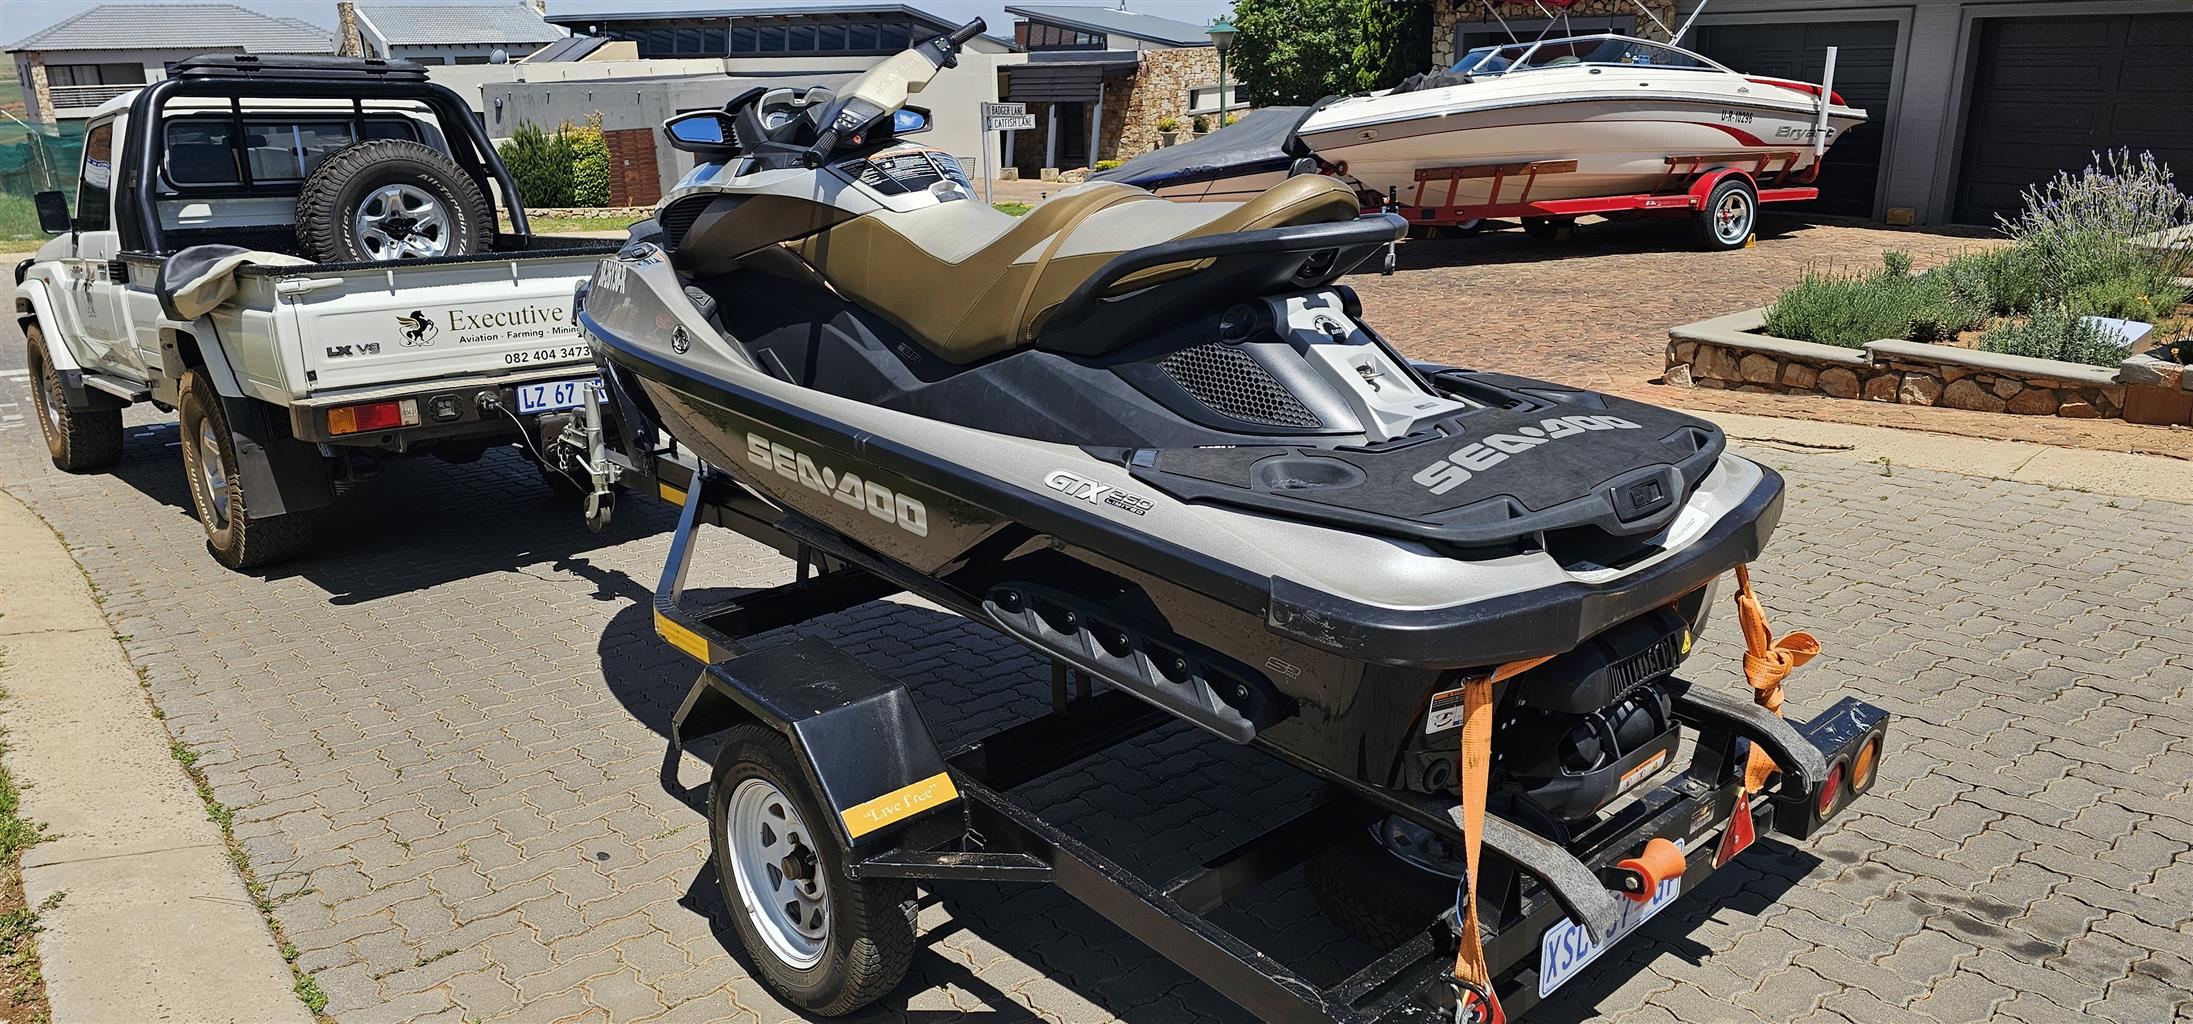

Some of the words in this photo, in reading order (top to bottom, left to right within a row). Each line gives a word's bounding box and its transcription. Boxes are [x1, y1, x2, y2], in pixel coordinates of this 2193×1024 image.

[991, 105, 1010, 116] BADGER
[1011, 105, 1024, 116] LANE
[994, 118, 1017, 128] CATFISH
[1018, 117, 1033, 127] LANE
[1774, 126, 1835, 141] Bryat
[449, 304, 564, 332] Executive
[459, 332, 498, 344] Aviation
[507, 328, 544, 341] Farming
[326, 344, 354, 358] LX
[355, 342, 381, 355] V8
[505, 352, 529, 364] 082
[533, 349, 556, 361] 404
[561, 346, 590, 358] 3473
[523, 386, 546, 409] LZ
[555, 382, 574, 404] 67
[1043, 470, 1111, 505] GTX
